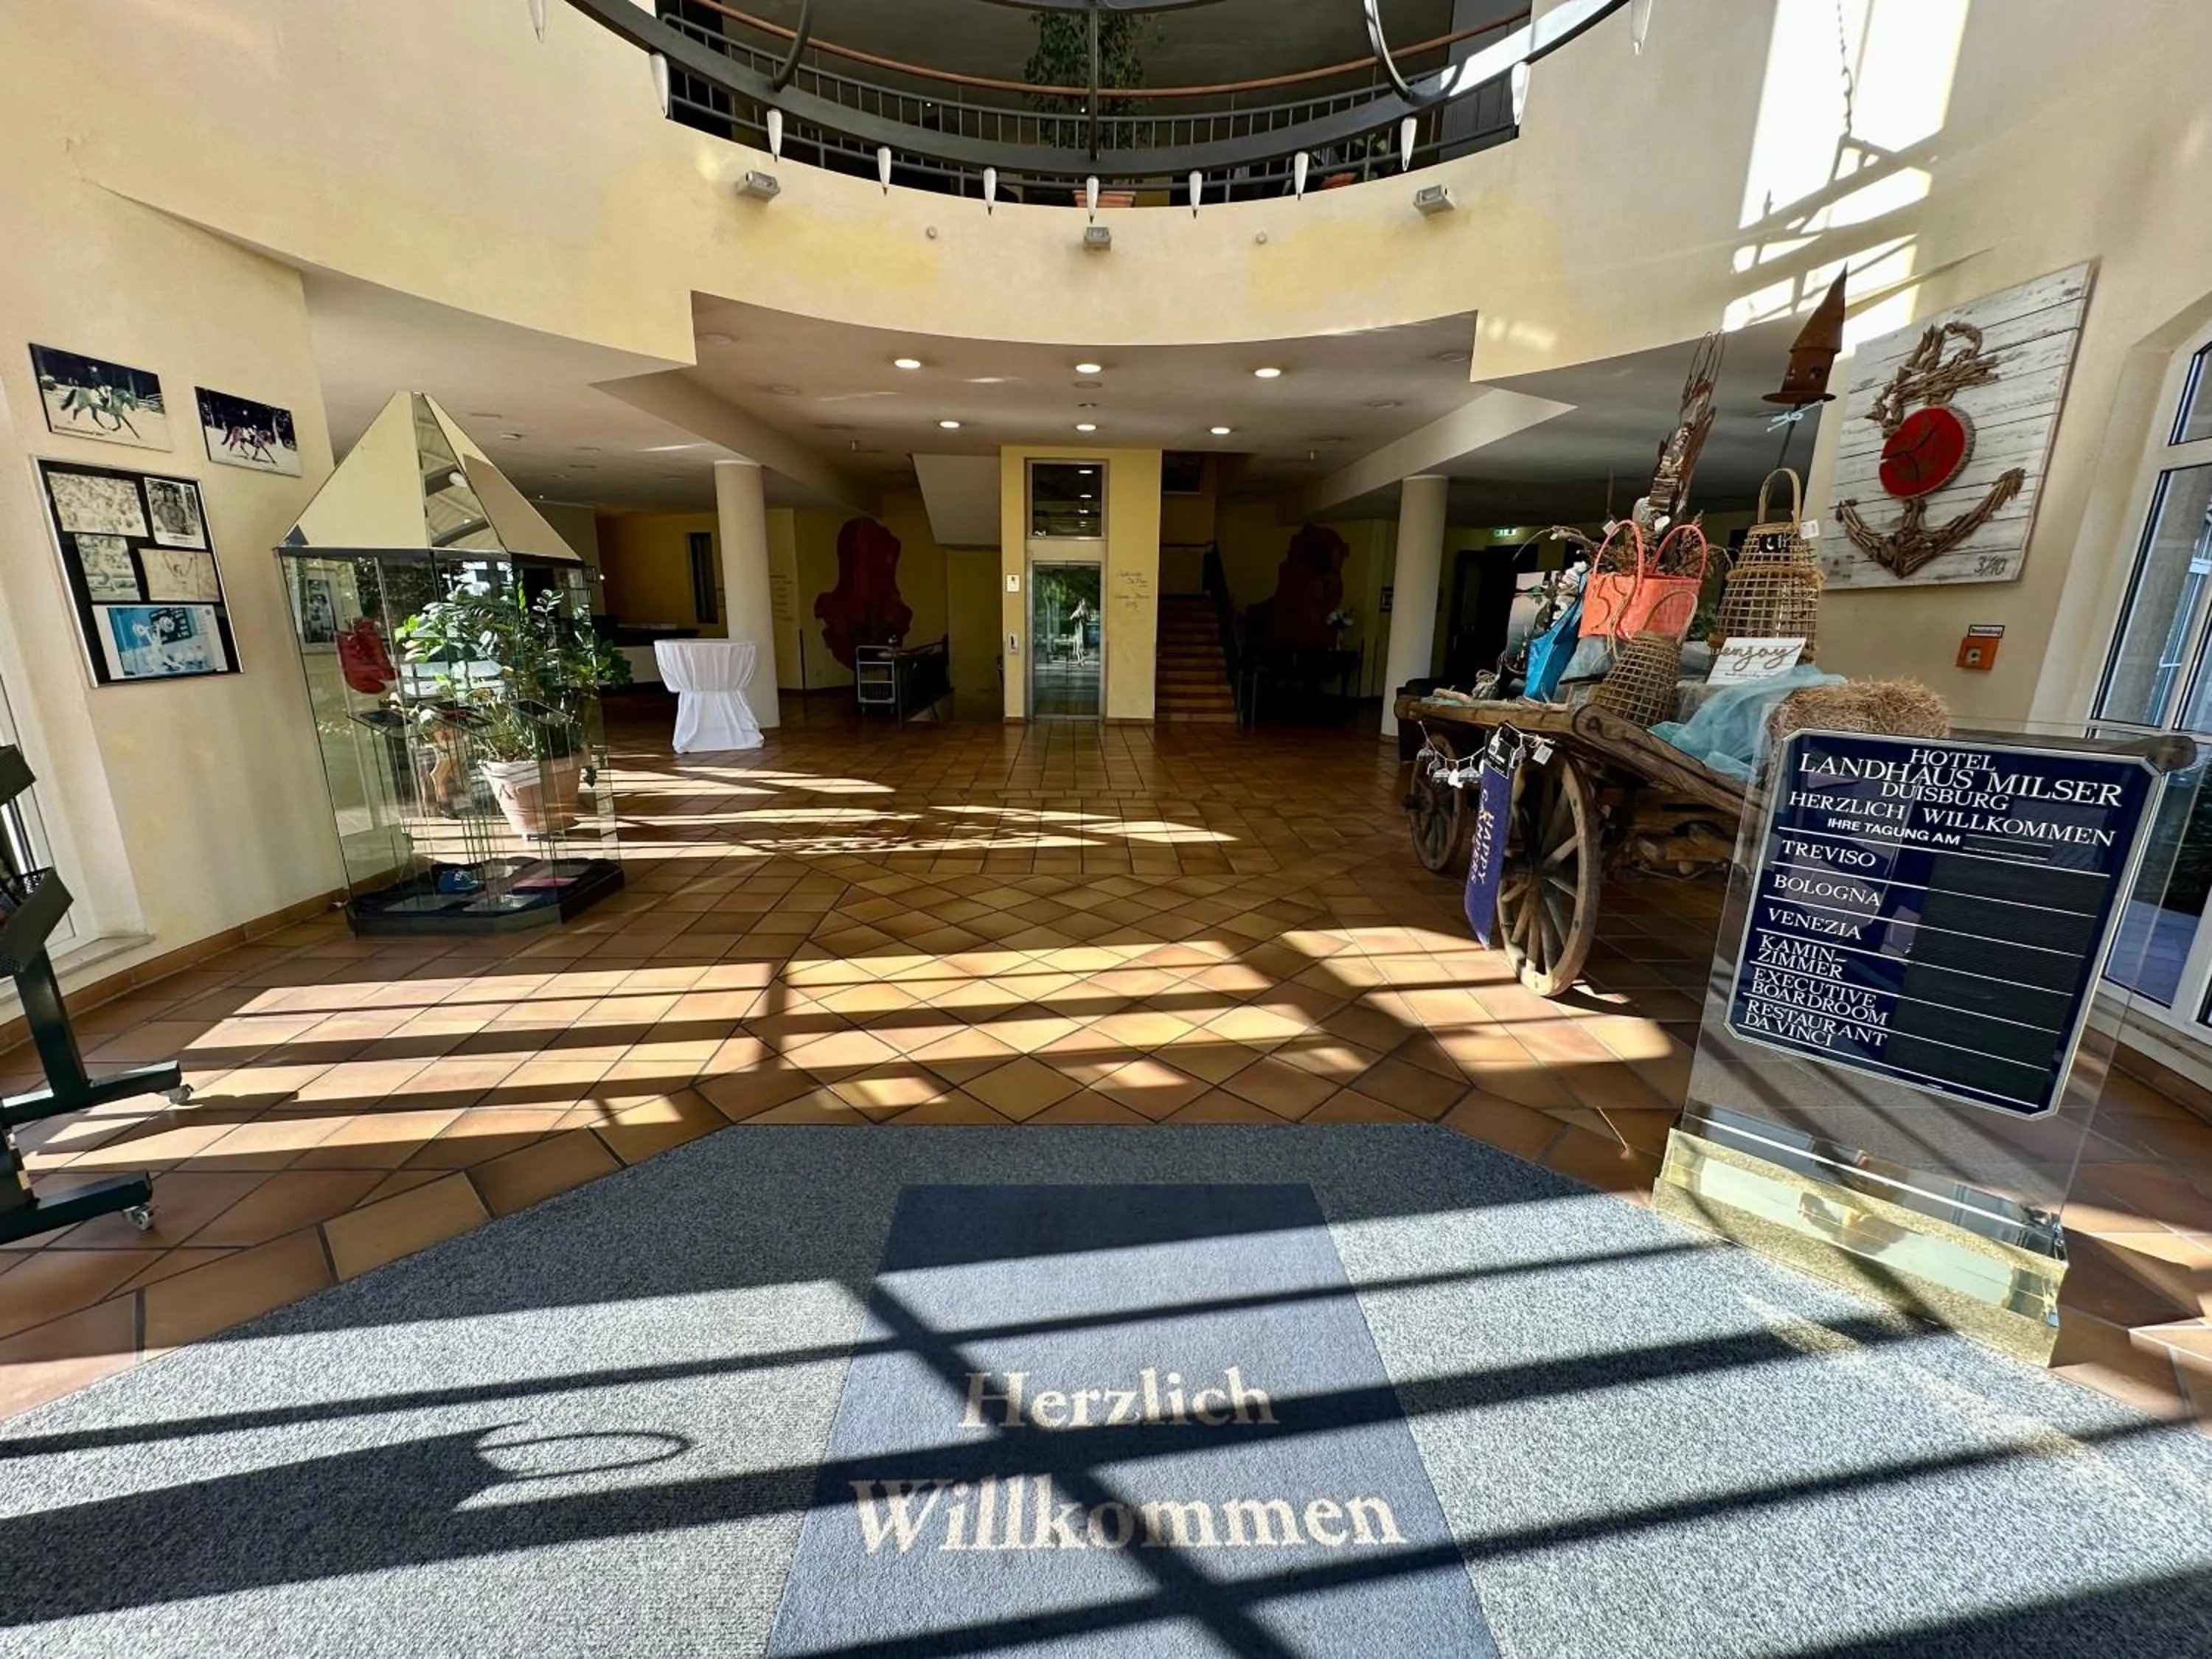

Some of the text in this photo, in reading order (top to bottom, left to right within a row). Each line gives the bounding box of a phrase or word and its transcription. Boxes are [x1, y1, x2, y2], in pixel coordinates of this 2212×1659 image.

[1718, 644, 1802, 671] enjoy
[1910, 748, 1995, 772] HOTEL
[1799, 753, 2123, 807] LANDHAUS MILSER
[1881, 782, 2010, 810] DUISBURG
[1789, 791, 2117, 847] HERZLICH WILLKOMMEN
[1827, 818, 1961, 846] IHRE TAGUNG AM
[1781, 839, 1876, 867] TREVISO
[1773, 874, 1880, 906] BOLOGNA
[1768, 908, 1862, 940] VENEZIA
[1757, 948, 1843, 980] ZIMMER
[1752, 981, 1888, 1026] BOARDROOM
[1754, 967, 1877, 1009] EXECUTIVE
[1745, 1012, 1833, 1047] DA VINCI
[1747, 999, 1888, 1047] RESTAURANT
[957, 1366, 1280, 1430] Herzlich
[848, 1474, 1410, 1556] Willkommen
